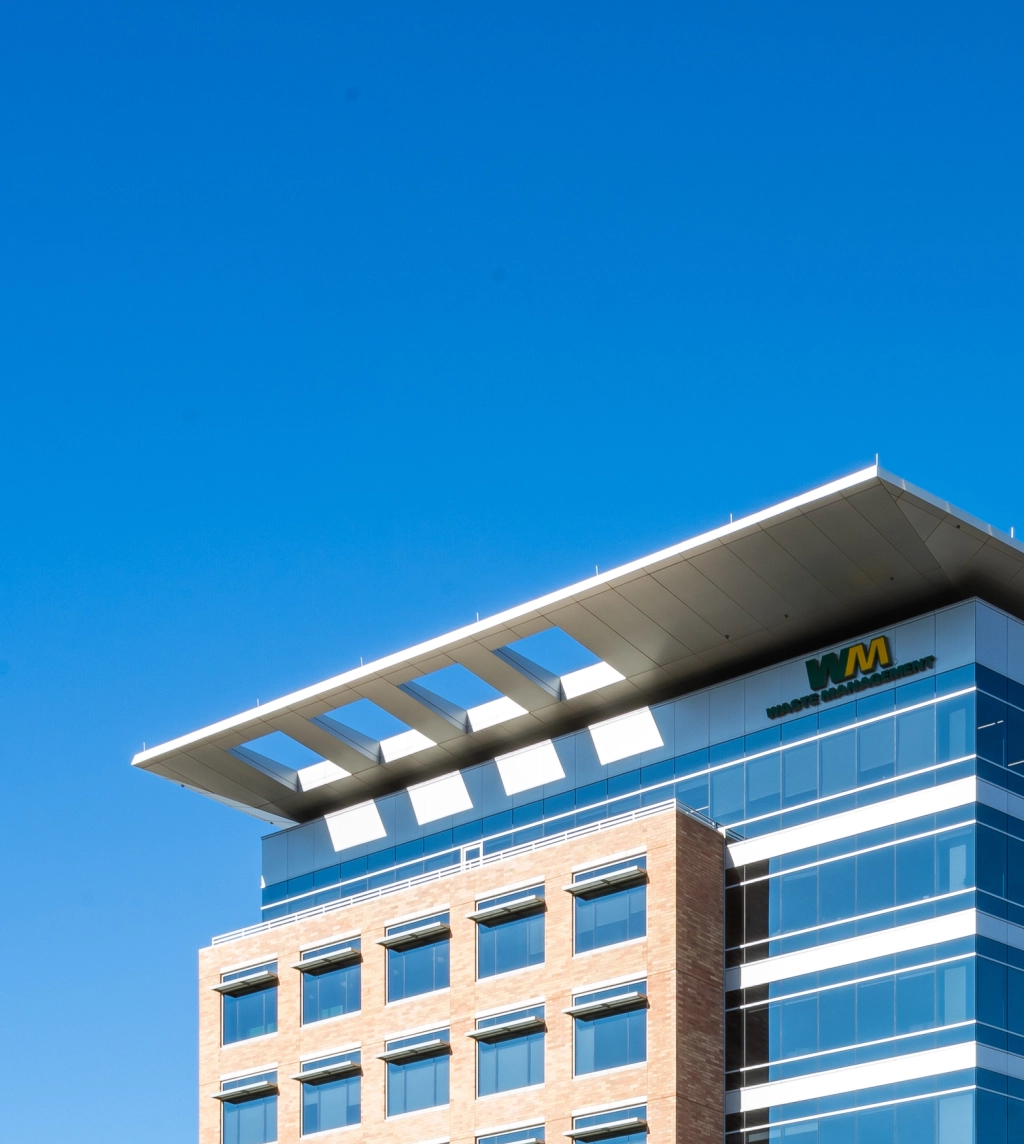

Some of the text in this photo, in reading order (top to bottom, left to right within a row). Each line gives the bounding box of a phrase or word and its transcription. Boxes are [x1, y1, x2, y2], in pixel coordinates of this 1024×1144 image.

[766, 655, 937, 720] WASTE MANAGEMENT
[805, 635, 893, 691] WM
